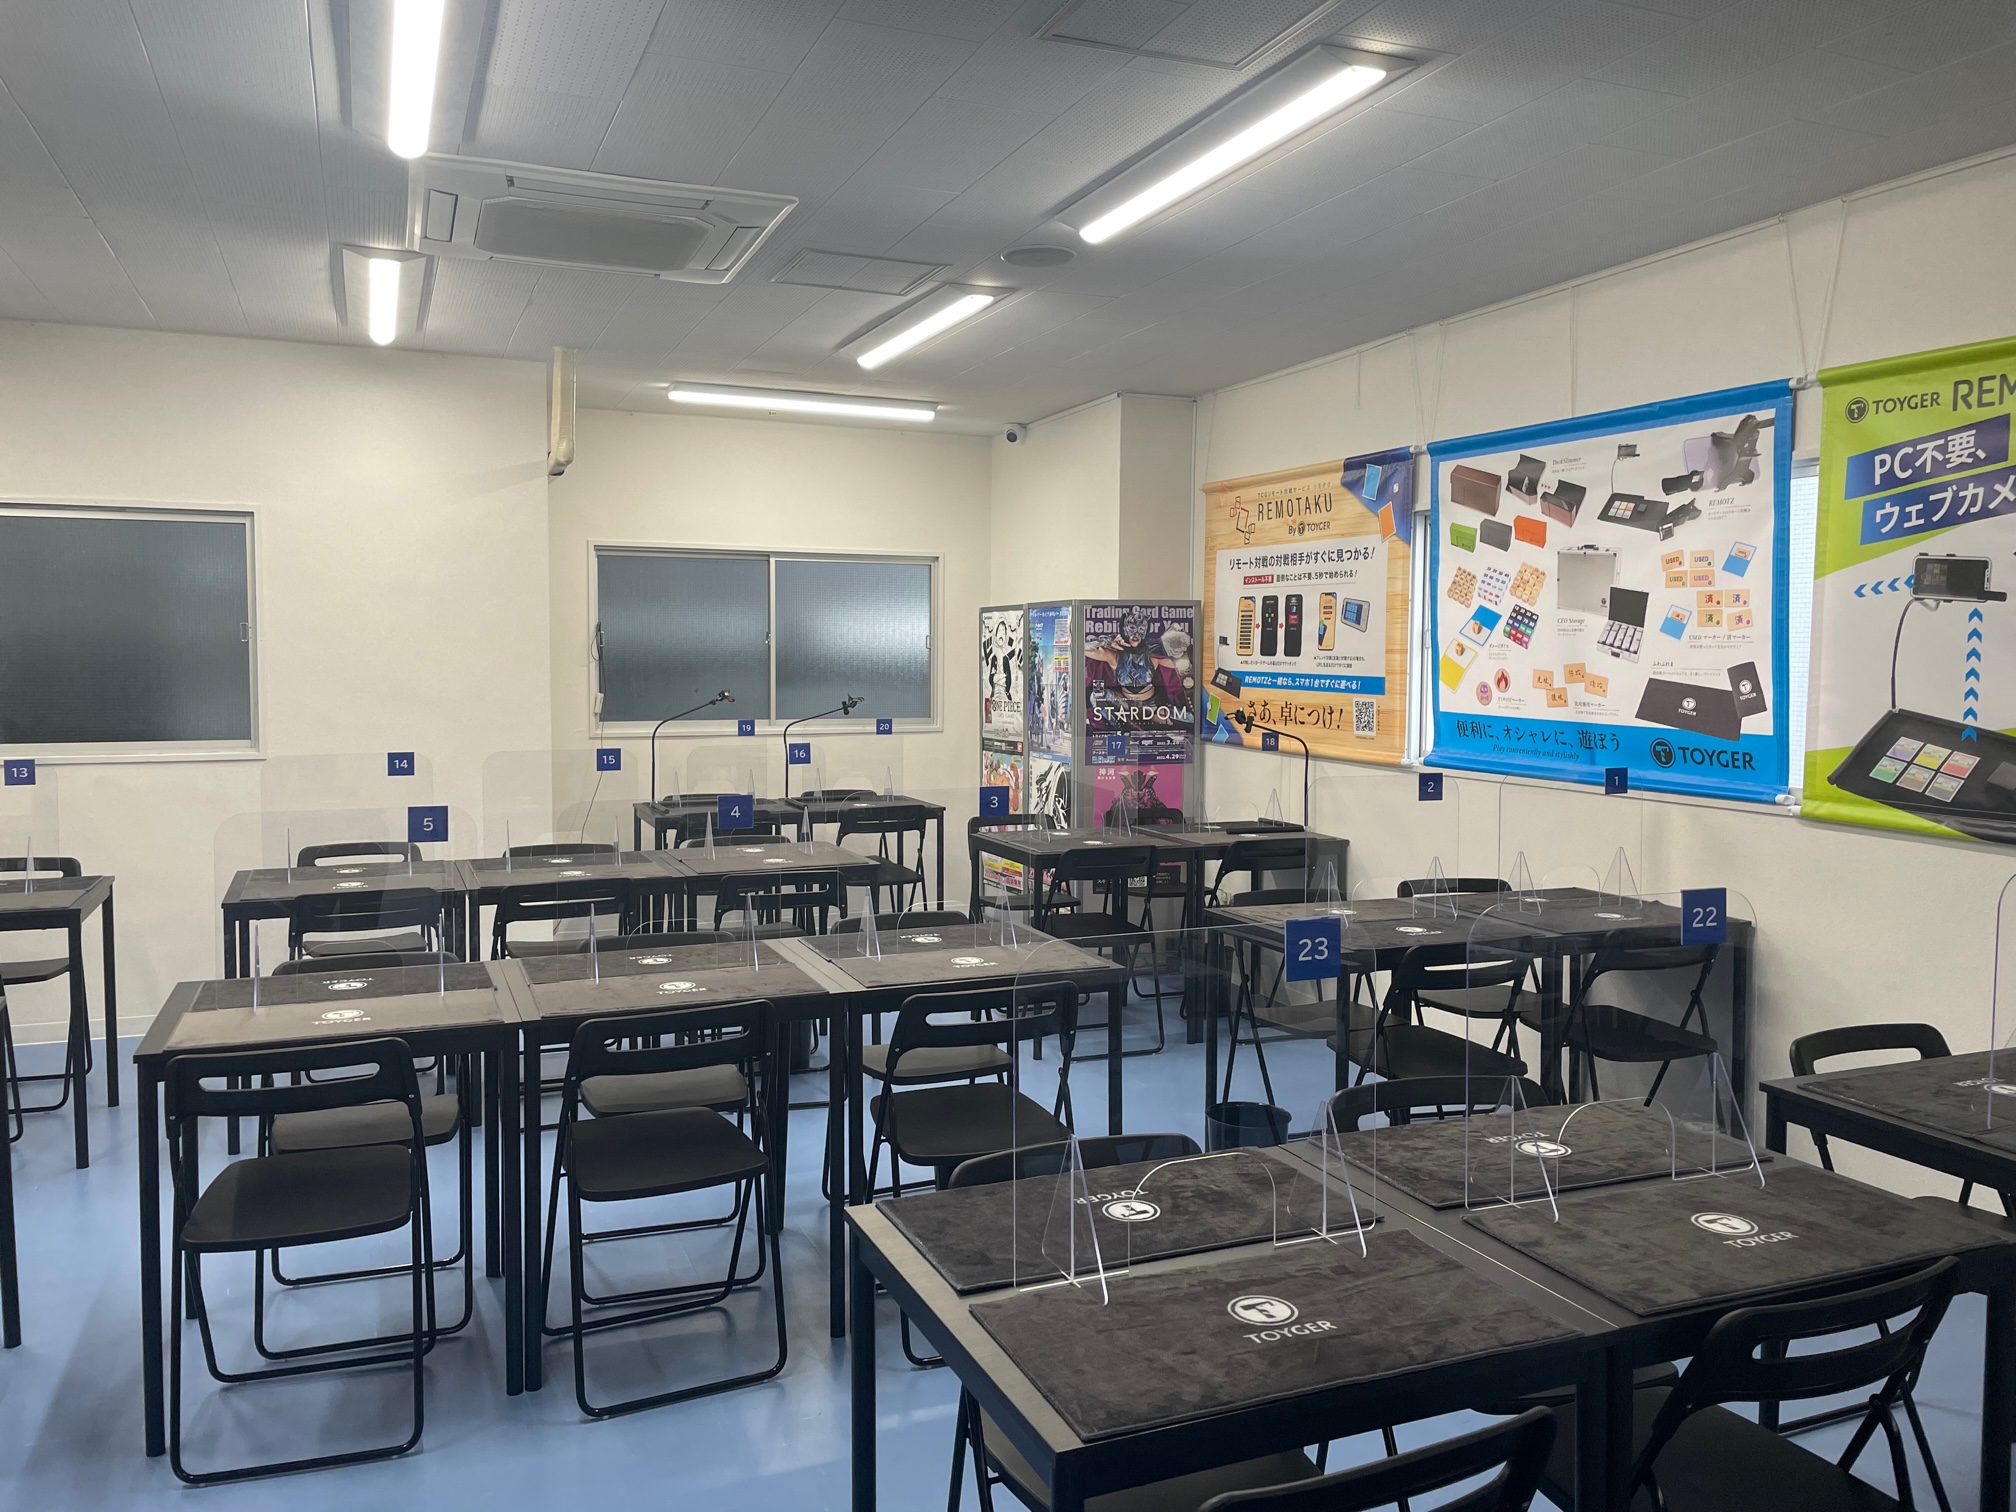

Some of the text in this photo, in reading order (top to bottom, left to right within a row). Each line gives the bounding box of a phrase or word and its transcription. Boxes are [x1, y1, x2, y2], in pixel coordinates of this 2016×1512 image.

[1873, 392, 1942, 415] TOYGER
[1874, 429, 1987, 486] PC不要、
[1257, 492, 1333, 521] REMOTAKU
[1875, 475, 2016, 534] ウェブカメ
[1288, 521, 1331, 536] By TOYGER
[1665, 556, 1680, 565] USED
[1705, 594, 1714, 604] 済
[1161, 606, 1193, 619] Game
[1003, 700, 1021, 712] PIECE
[1093, 705, 1187, 722] STARDOM
[879, 723, 890, 731] 20
[1112, 742, 1122, 750] 17
[1265, 738, 1276, 746] 18
[602, 755, 616, 765] 15
[794, 749, 806, 758] 16
[1678, 746, 1756, 771] TOYGER
[394, 760, 408, 768] 14
[11, 767, 28, 778] 13
[1427, 782, 1434, 793] 2
[1614, 776, 1619, 787] 1
[990, 796, 998, 808] 3
[730, 804, 740, 819] 4
[423, 818, 434, 831] 5
[1692, 906, 1718, 928] 22
[1298, 937, 1328, 962] 23
[1722, 1231, 1799, 1248] TOYGER
[1243, 1320, 1338, 1344] TOYGER
